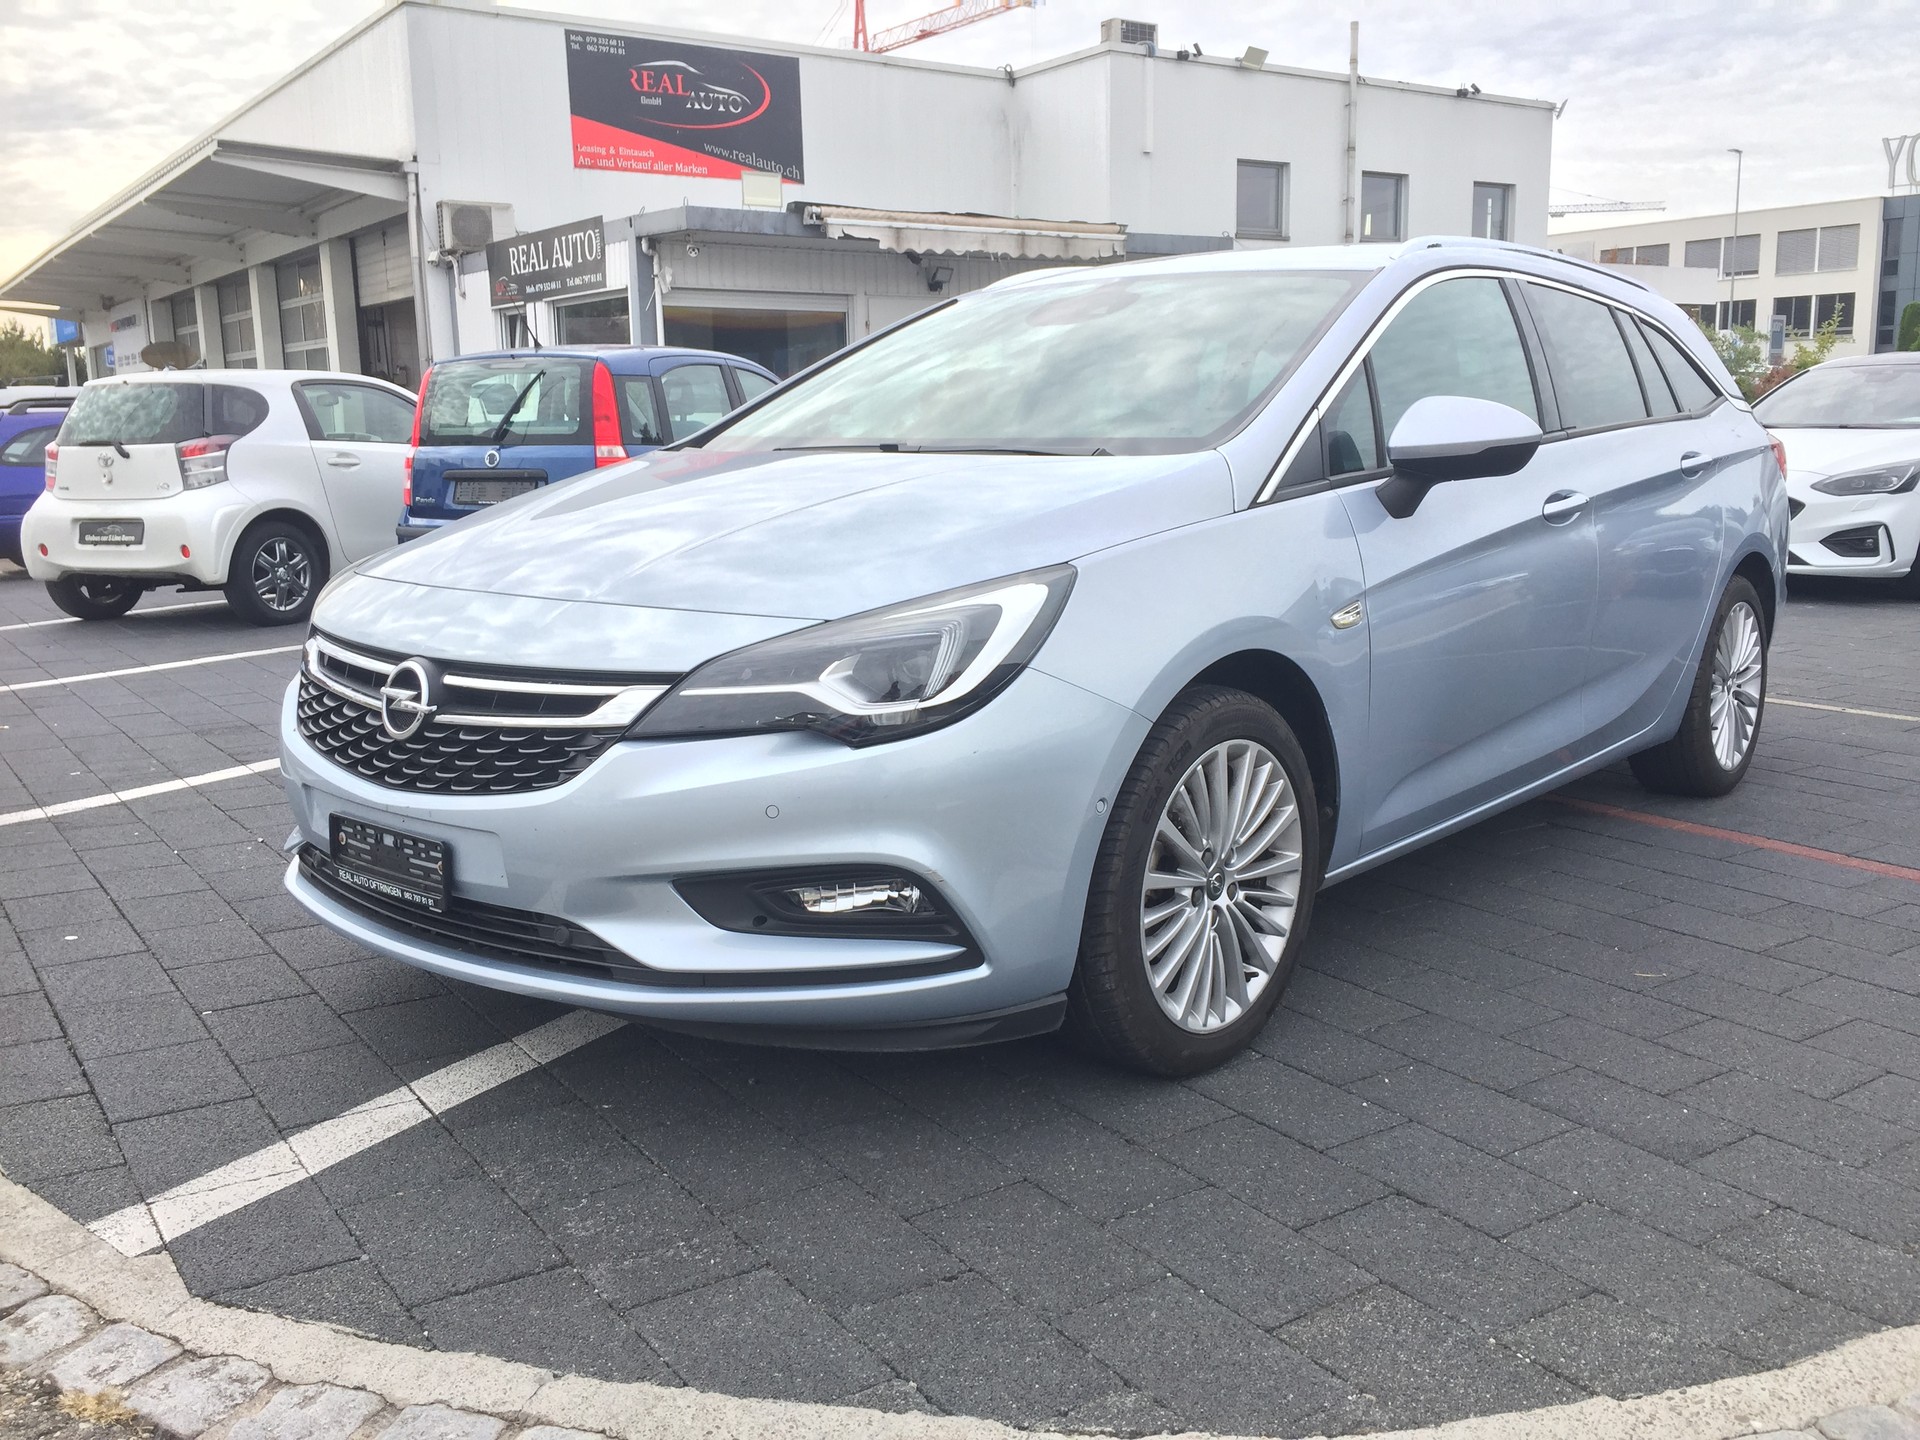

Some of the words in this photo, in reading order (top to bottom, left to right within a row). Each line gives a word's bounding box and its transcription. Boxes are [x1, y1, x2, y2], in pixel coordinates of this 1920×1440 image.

[629, 68, 692, 96] REAL
[640, 96, 662, 106] GmbH
[686, 91, 742, 113] AUTO
[577, 144, 606, 155] Leasing
[609, 146, 616, 154] &
[619, 146, 654, 158] Eintausch
[704, 142, 800, 180] www.realauto.ch
[578, 155, 594, 166] An-
[597, 157, 614, 168] und
[617, 158, 652, 170] Verkauf
[654, 162, 673, 172] aller
[676, 163, 708, 174] Marken
[508, 241, 548, 276] REAL
[552, 229, 596, 268] AUTO
[566, 278, 574, 287] Tel.
[415, 496, 436, 504] Panda
[338, 869, 354, 882] REAL
[354, 874, 368, 887] AUTO
[369, 880, 402, 898] OFTRINGEN
